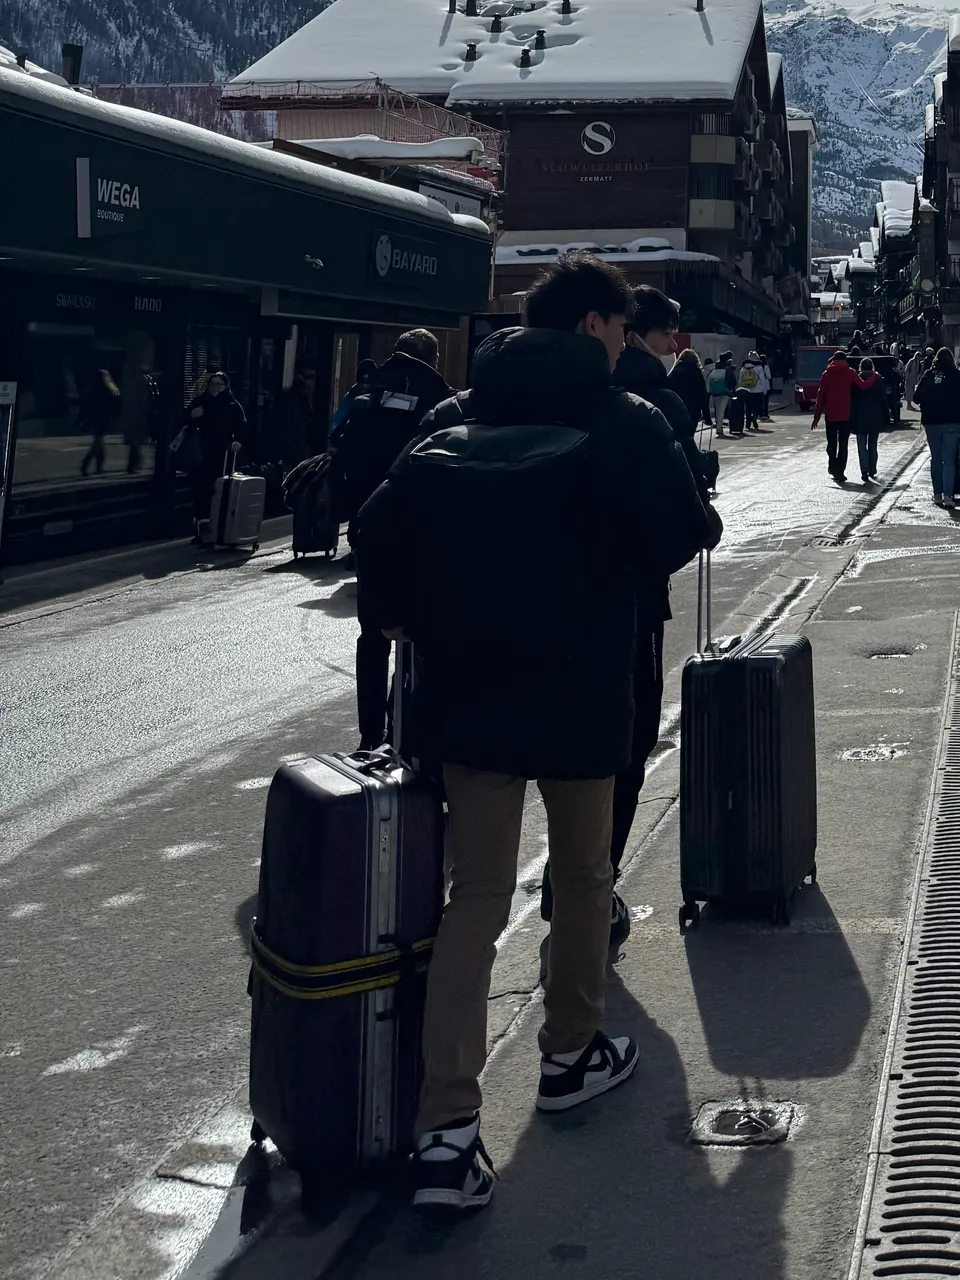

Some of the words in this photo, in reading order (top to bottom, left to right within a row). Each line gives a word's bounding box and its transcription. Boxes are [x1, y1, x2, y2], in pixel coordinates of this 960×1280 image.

[97, 177, 140, 209] WEGA
[97, 209, 124, 223] BOUTIQUE
[391, 249, 438, 275] BAYARD
[134, 296, 162, 312] RADO
